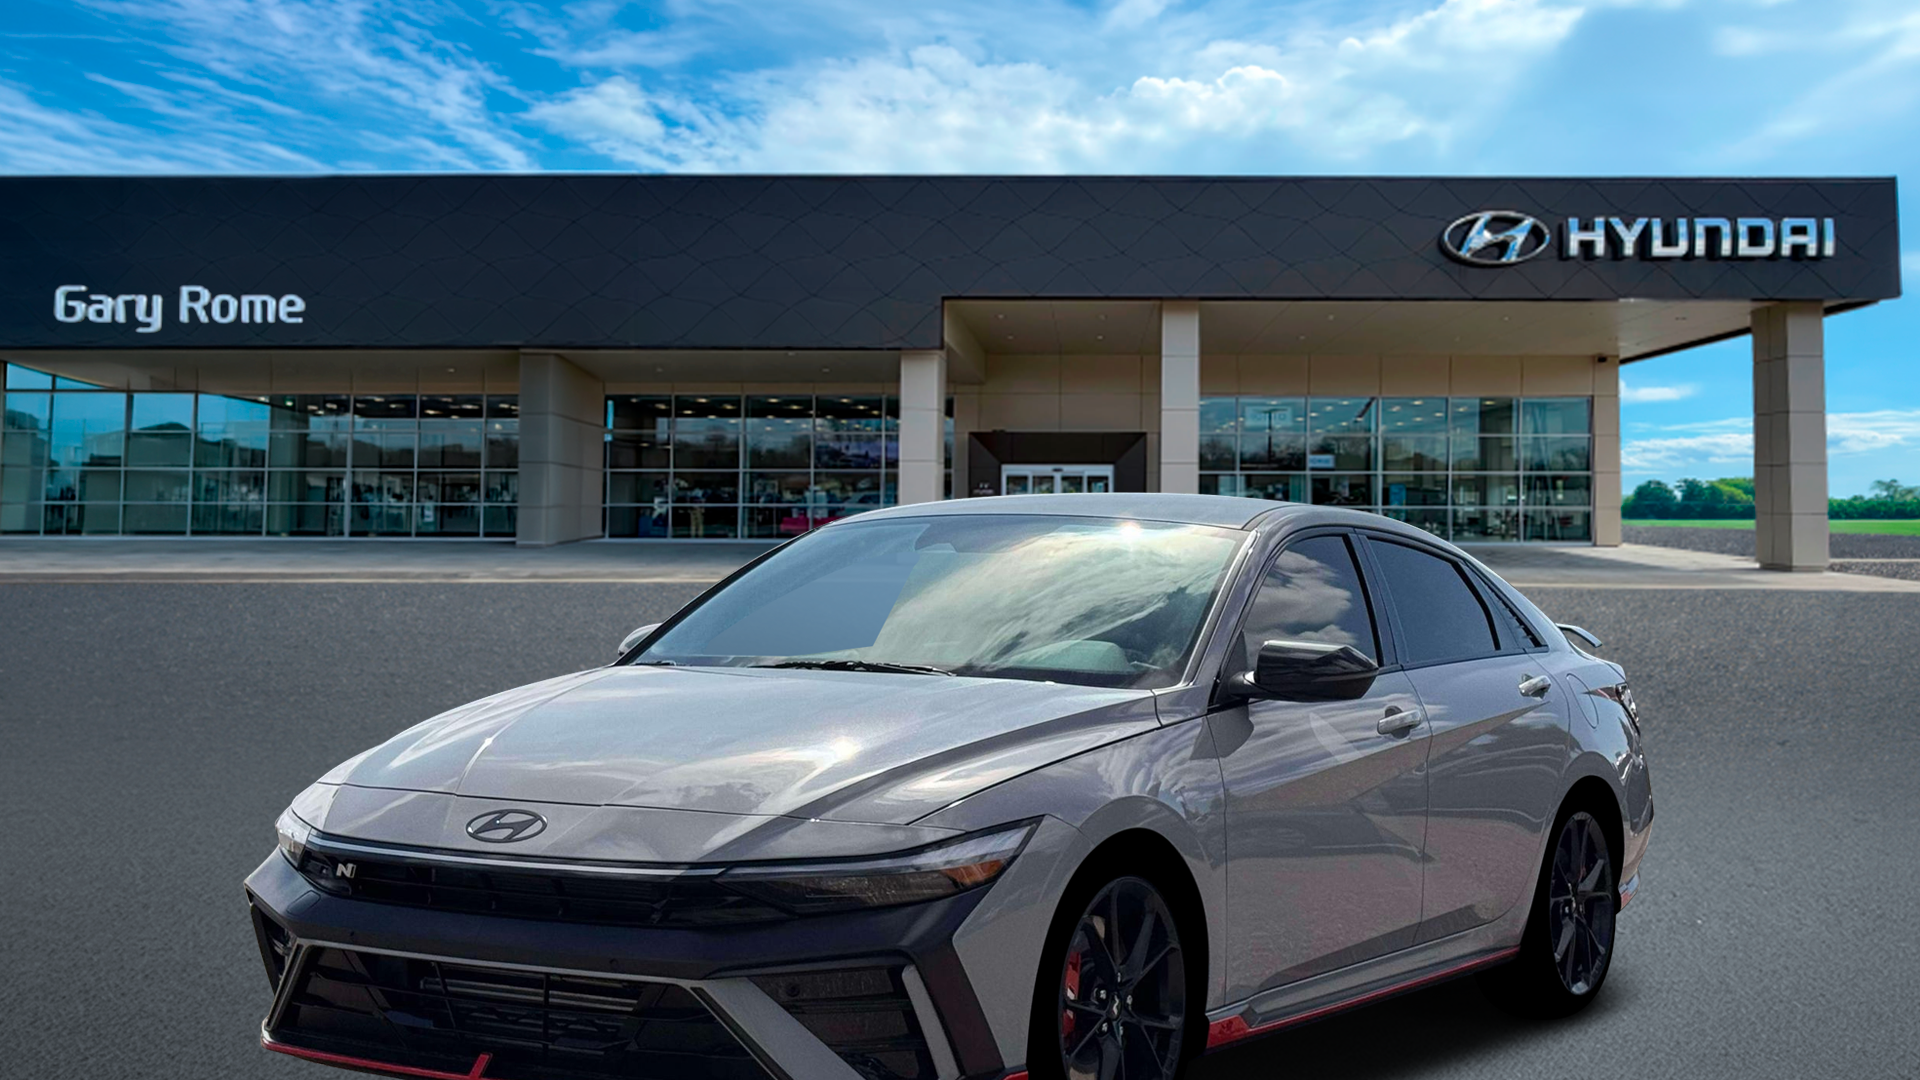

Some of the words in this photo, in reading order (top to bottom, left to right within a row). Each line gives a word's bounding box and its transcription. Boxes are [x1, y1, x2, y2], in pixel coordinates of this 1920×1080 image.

[1567, 217, 1835, 257] HYUNDAI
[54, 285, 163, 333] Gary
[179, 285, 306, 324] Rome
